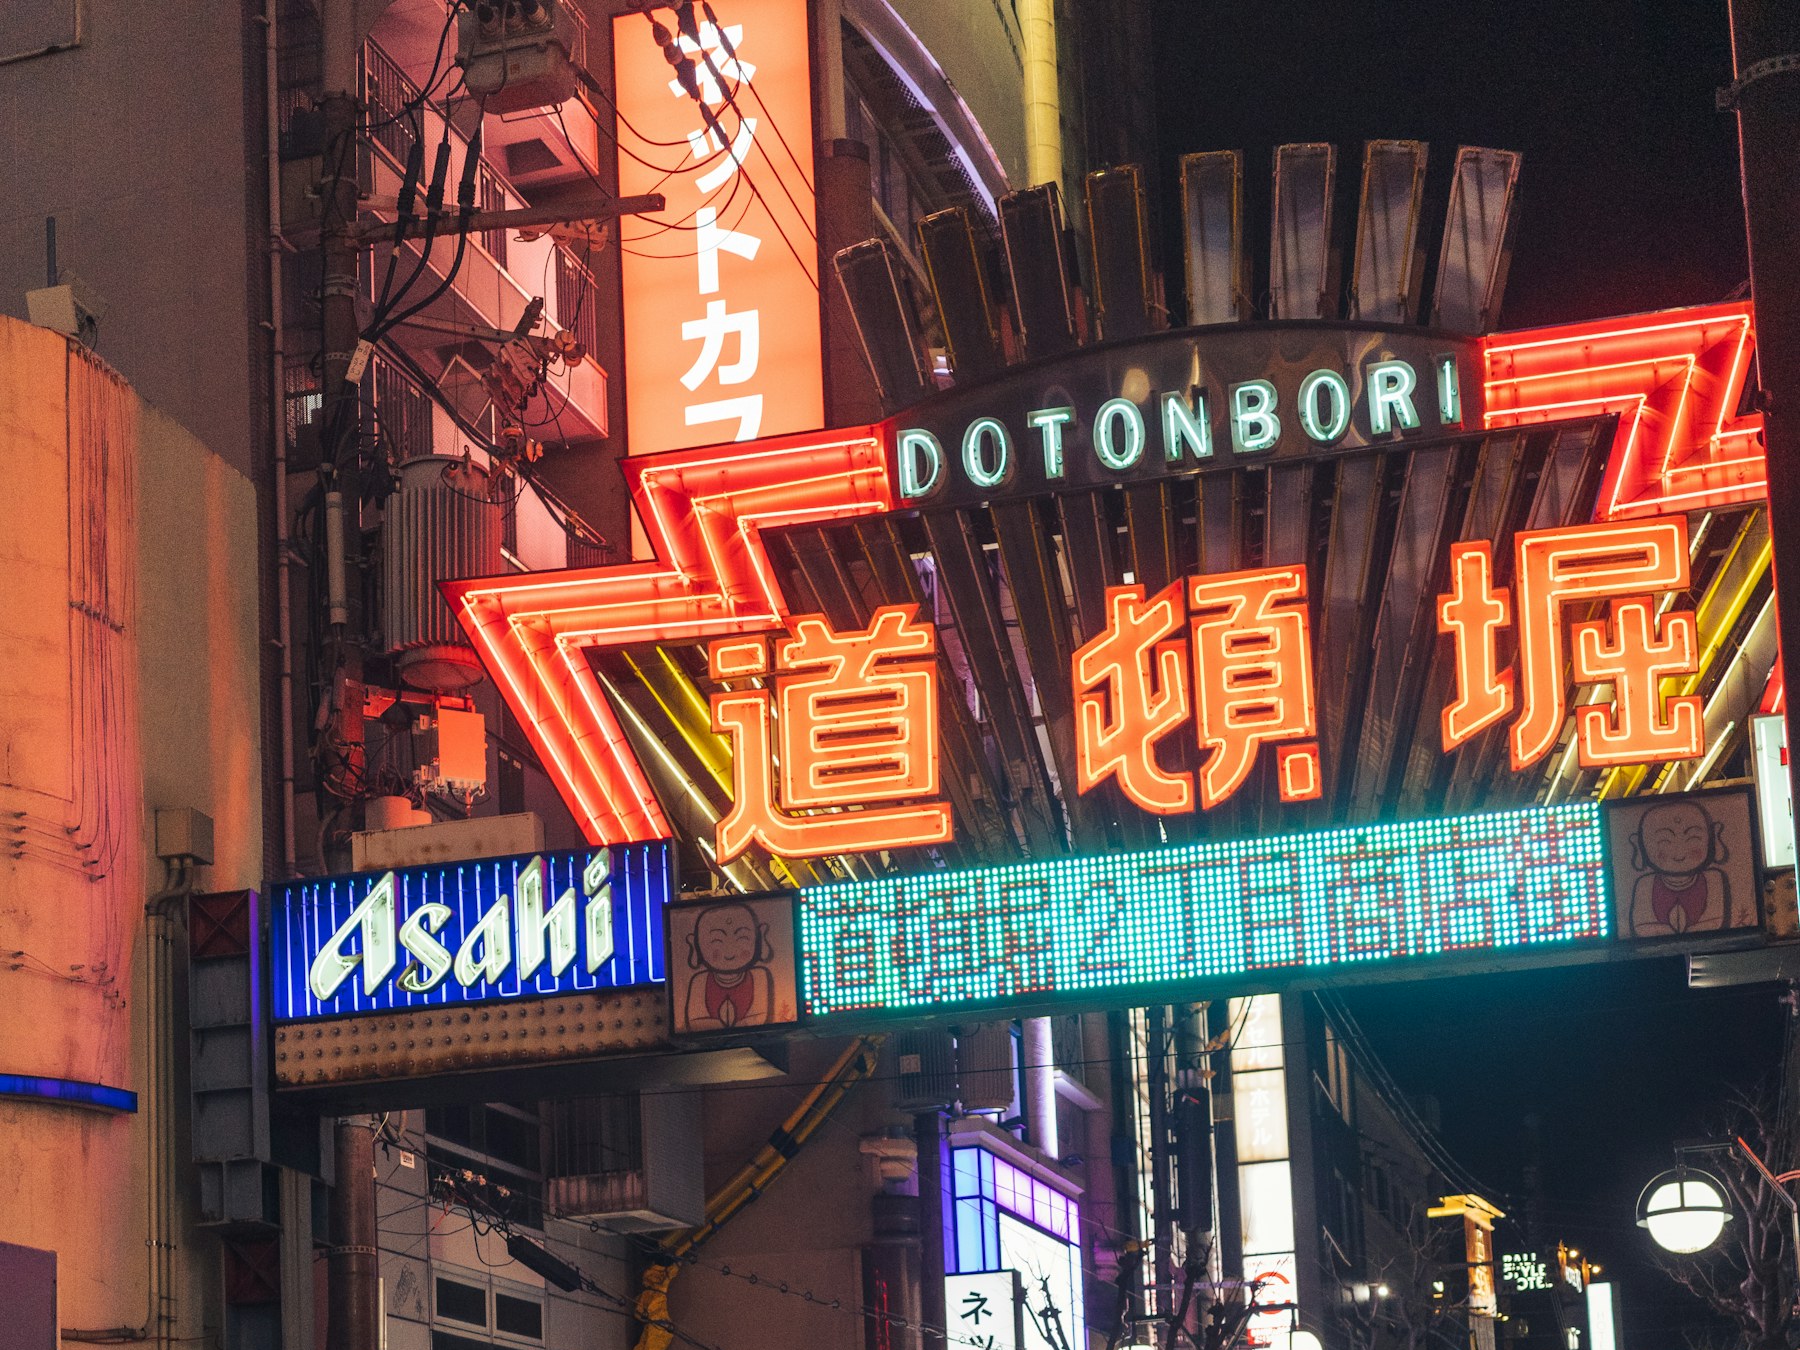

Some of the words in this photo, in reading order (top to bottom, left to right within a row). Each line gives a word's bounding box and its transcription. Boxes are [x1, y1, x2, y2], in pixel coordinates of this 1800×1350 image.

[896, 356, 1463, 500] DOTONBORI
[709, 515, 1705, 865] 道頓堀
[310, 847, 614, 1001] Asahi
